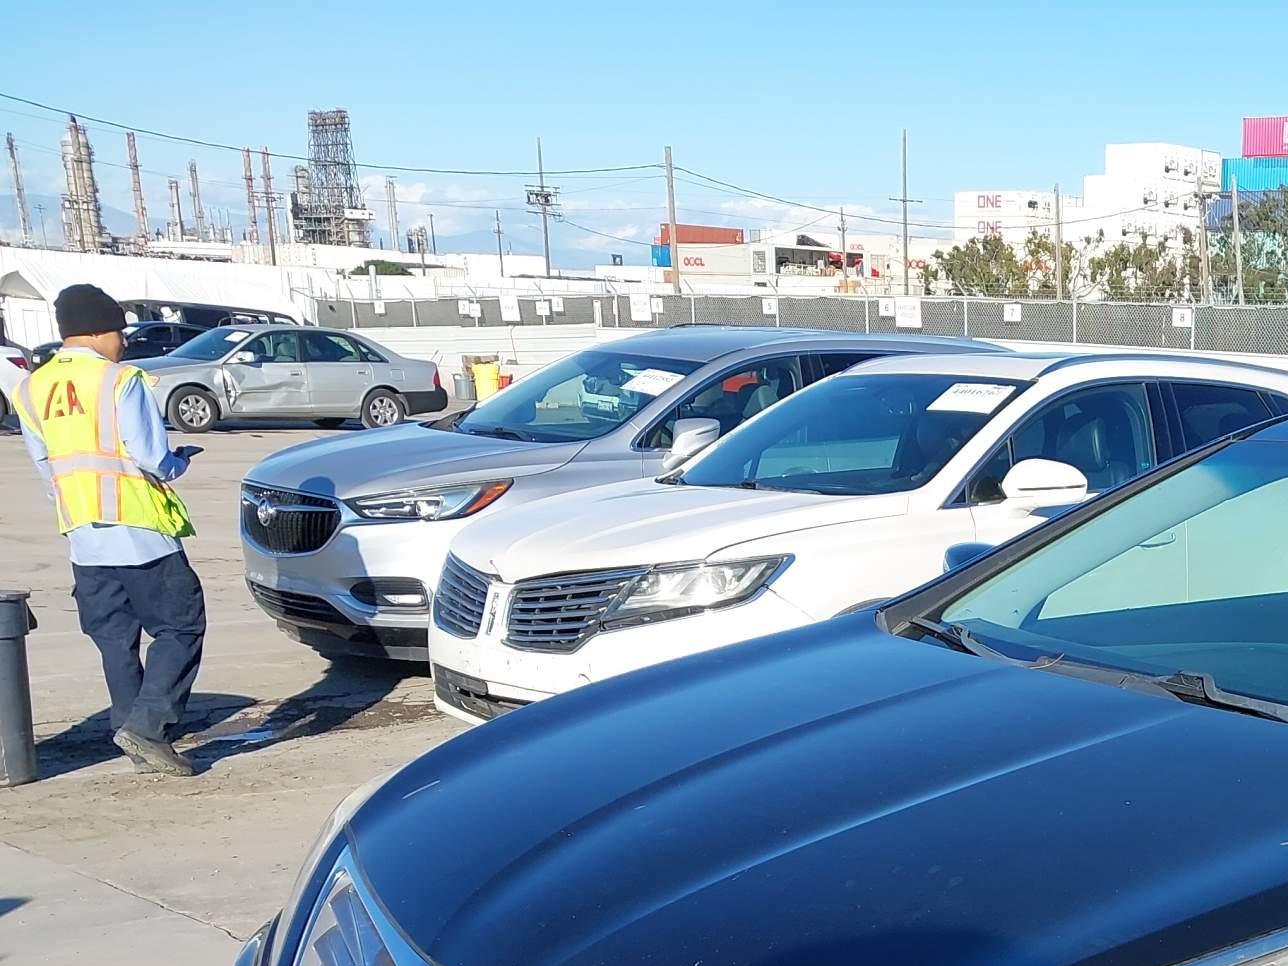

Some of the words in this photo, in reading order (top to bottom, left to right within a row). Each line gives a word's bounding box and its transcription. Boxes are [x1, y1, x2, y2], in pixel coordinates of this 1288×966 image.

[978, 194, 1002, 208] ONE
[978, 221, 1002, 234] ONE
[684, 256, 705, 267] OOCL
[884, 303, 889, 311] 6
[1010, 308, 1015, 317] 7
[1179, 313, 1185, 322] 8
